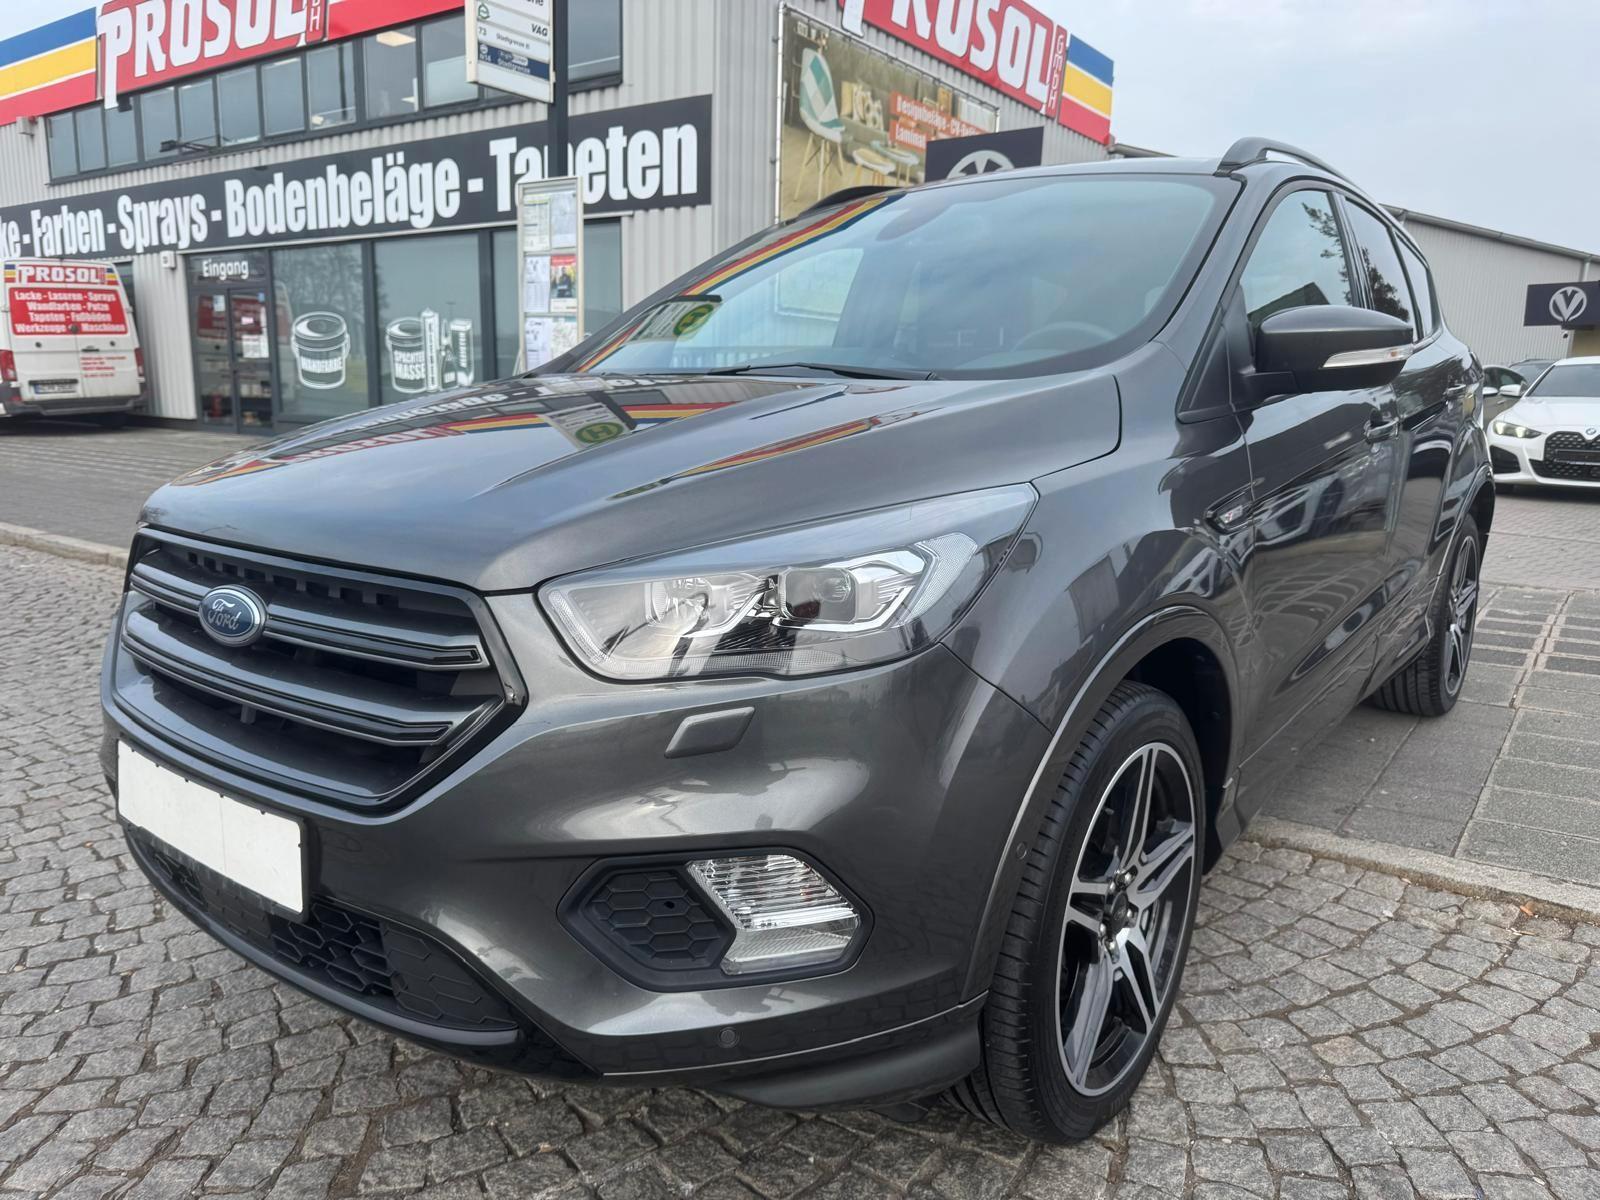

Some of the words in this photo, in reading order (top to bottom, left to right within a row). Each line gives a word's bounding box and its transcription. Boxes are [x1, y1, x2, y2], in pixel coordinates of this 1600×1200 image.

[531, 24, 548, 36] VAG
[30, 204, 106, 257] Farben
[117, 194, 208, 253] Sprays
[225, 151, 460, 238] Bodenbeläge
[489, 123, 698, 212] Taeten
[17, 265, 100, 287] PROSOL
[202, 259, 249, 280] Eingang
[208, 599, 242, 630] Ford
